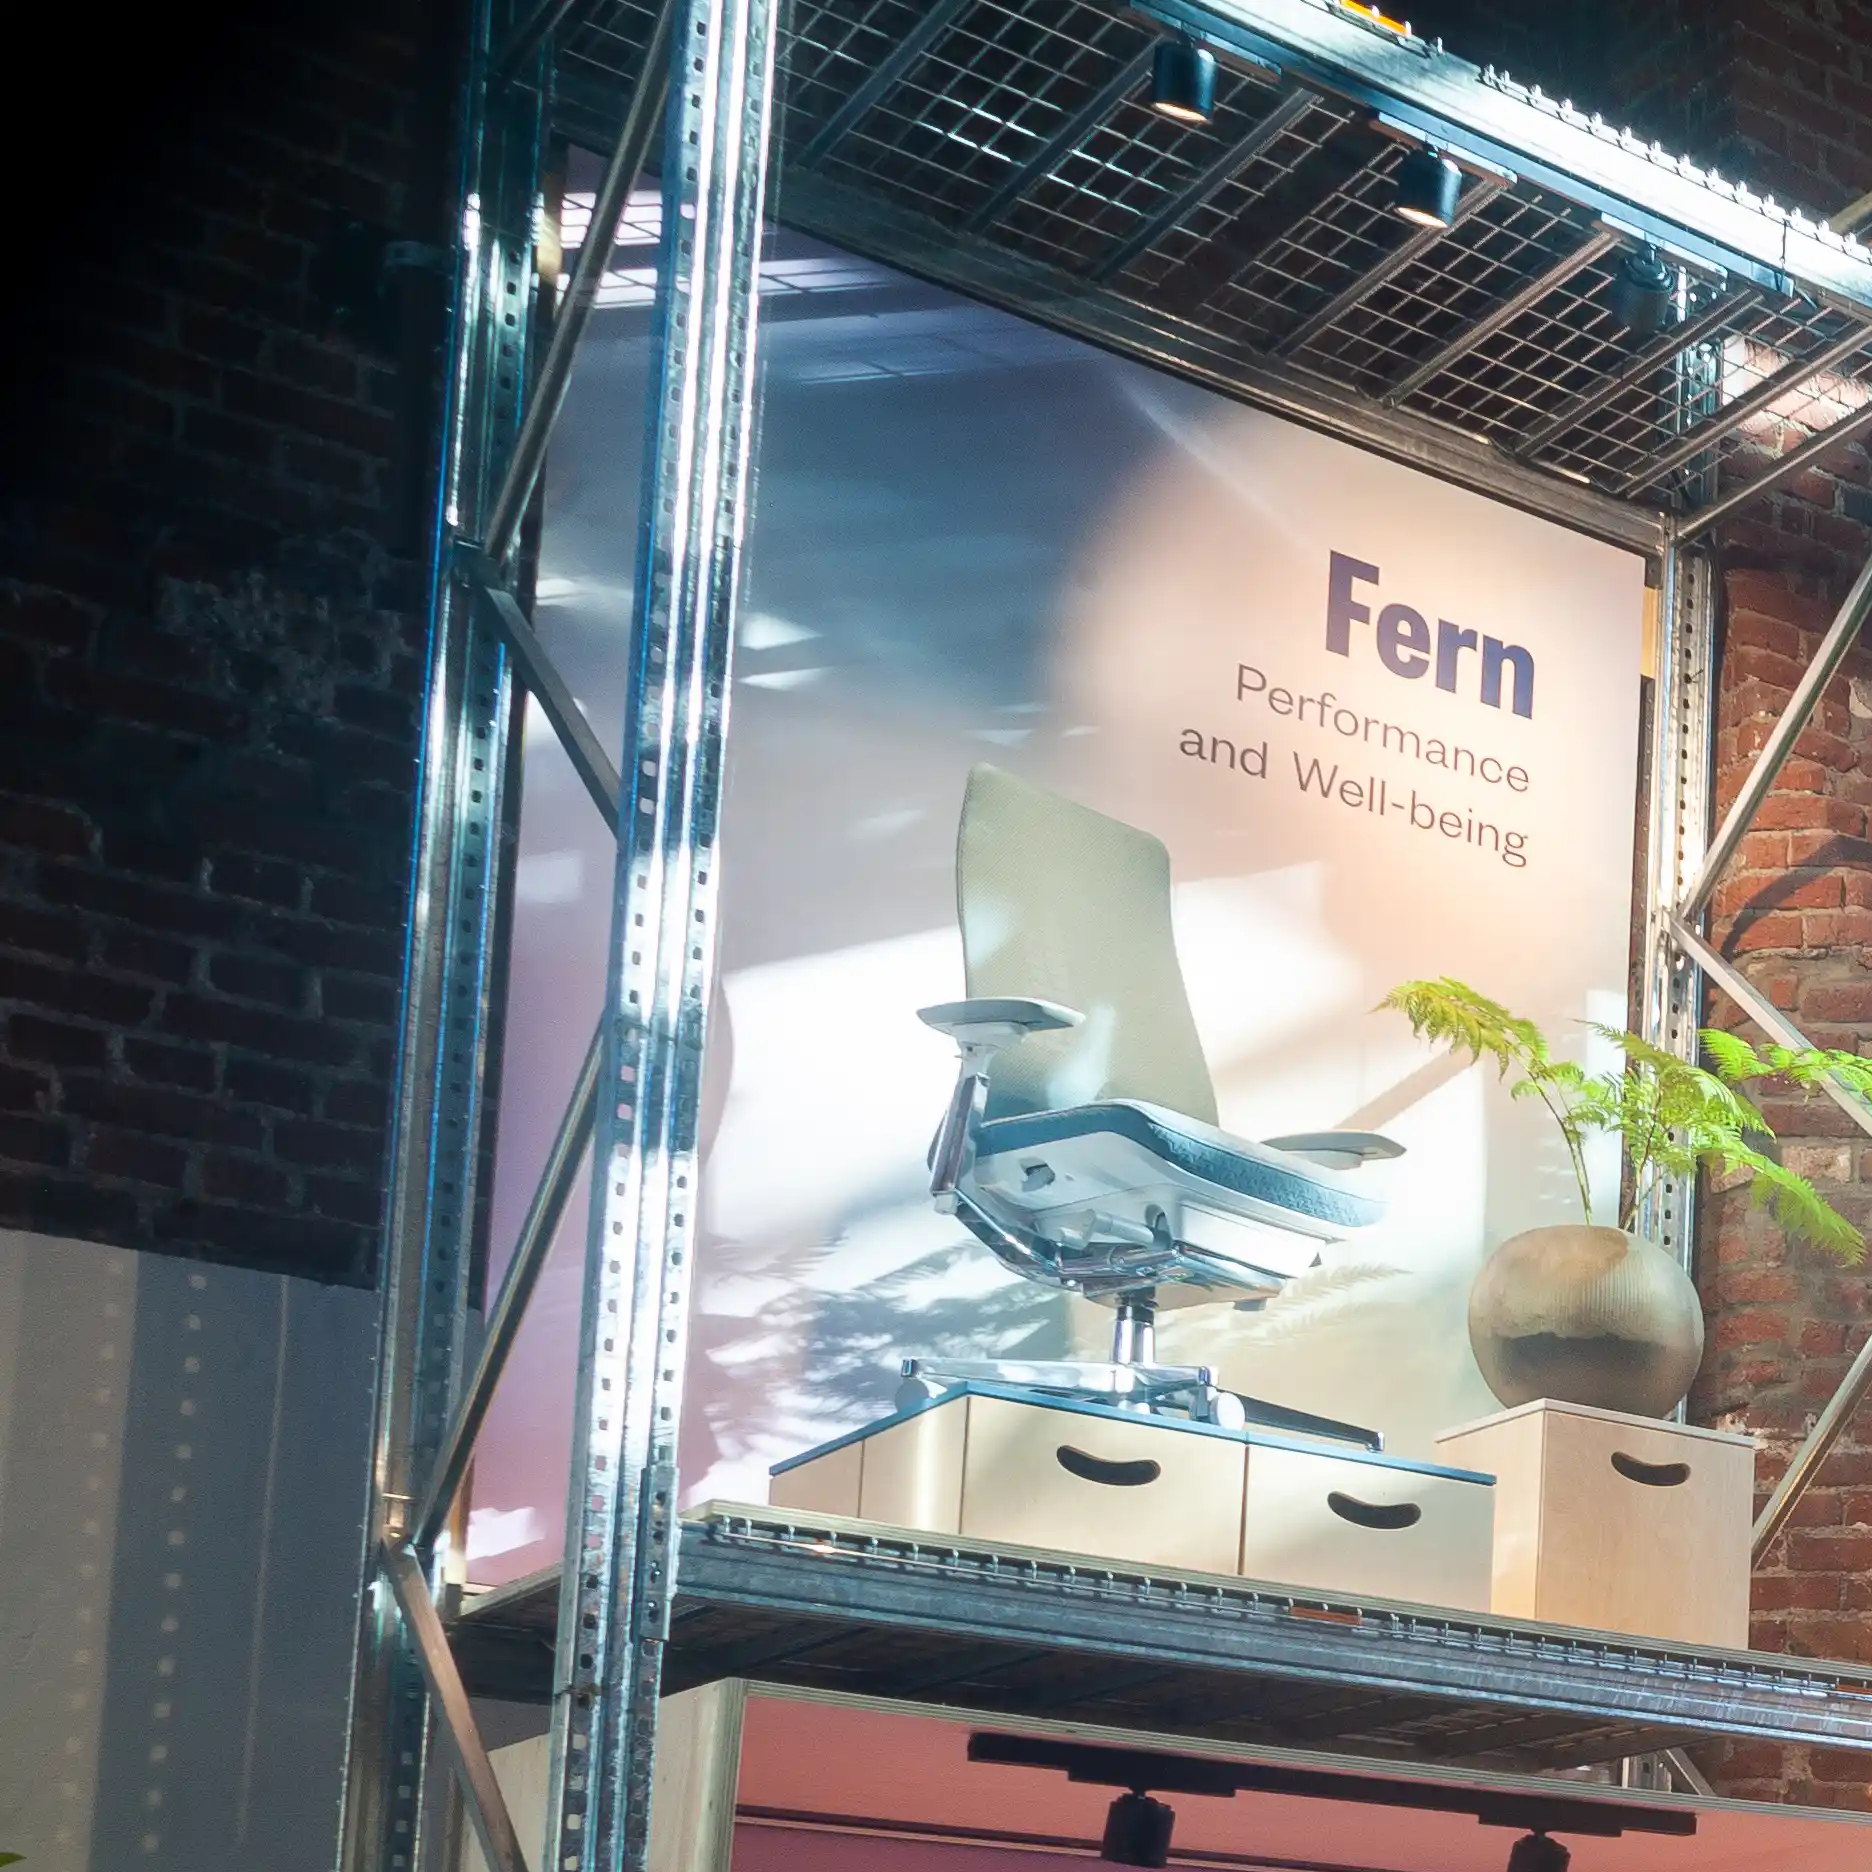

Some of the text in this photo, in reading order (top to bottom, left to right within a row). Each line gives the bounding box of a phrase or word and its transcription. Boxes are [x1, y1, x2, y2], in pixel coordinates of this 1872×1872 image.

[1325, 549, 1535, 720] Fern
[1179, 727, 1530, 868] and Well-being
[1236, 663, 1530, 793] Performance
